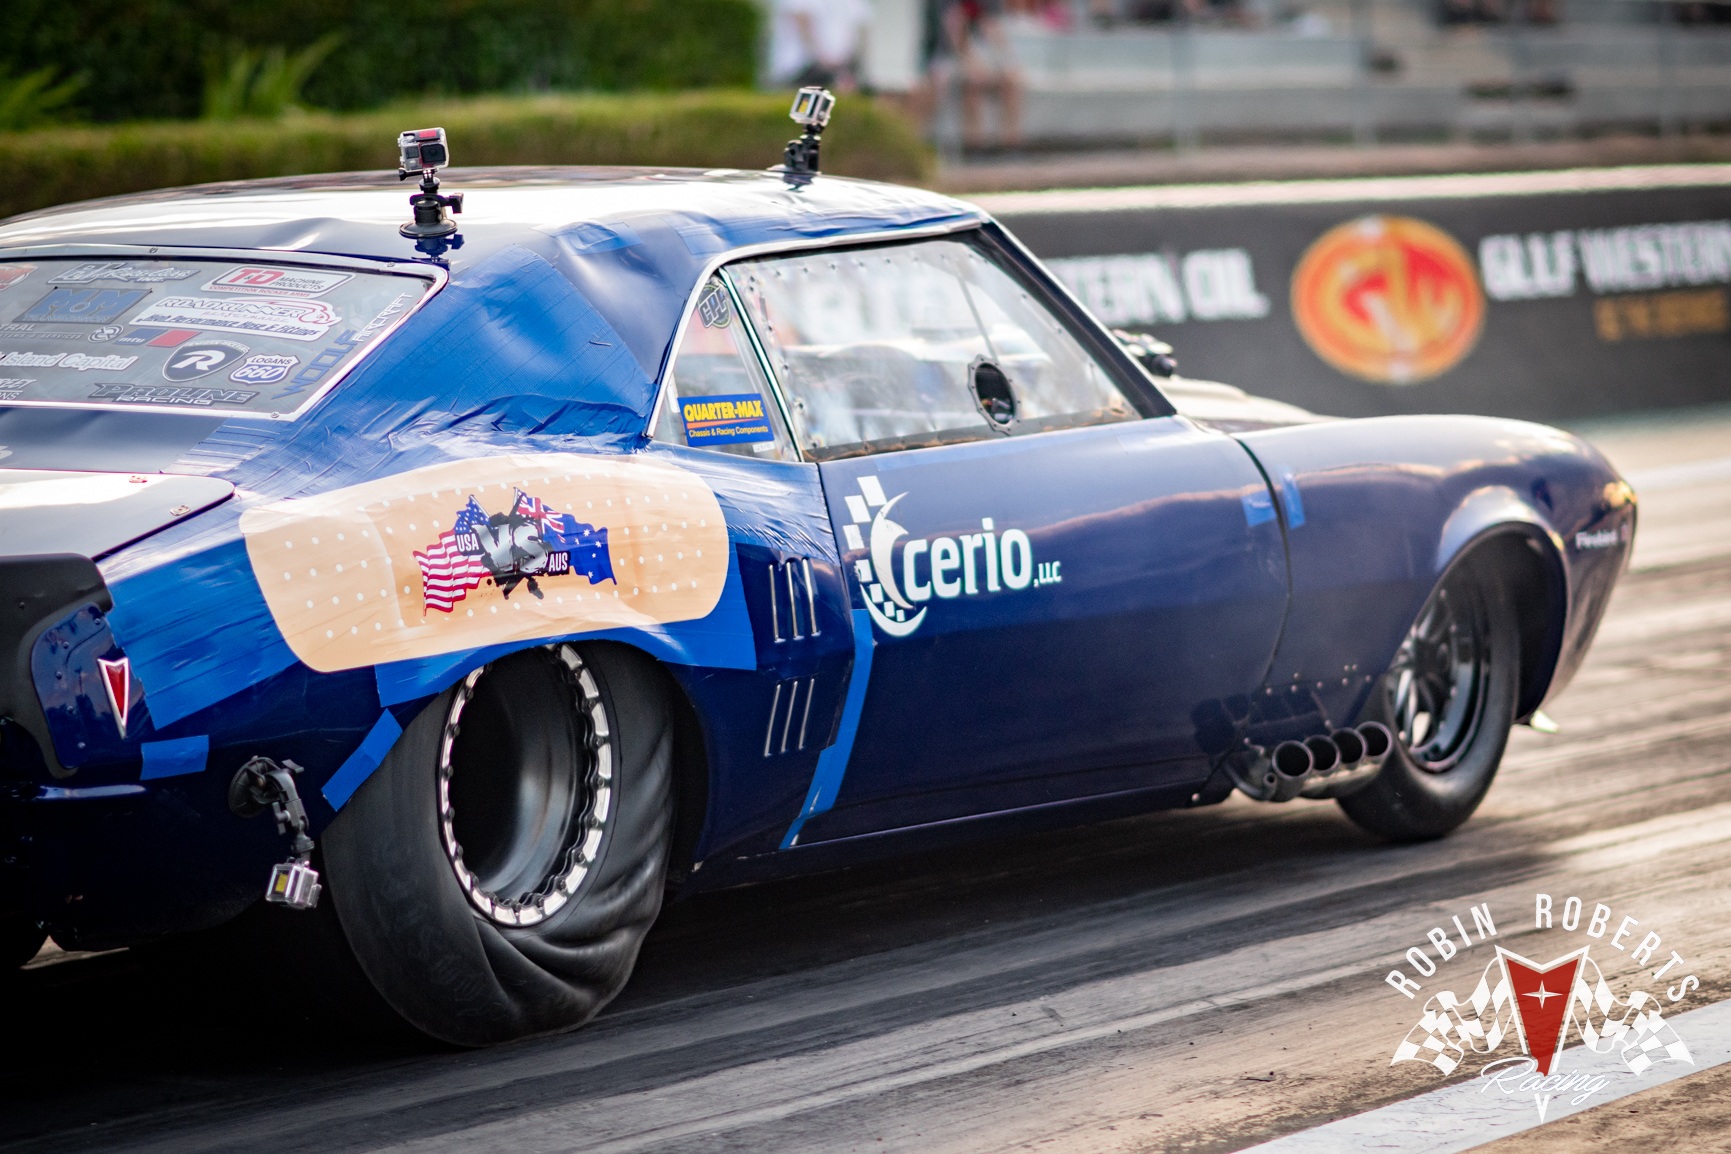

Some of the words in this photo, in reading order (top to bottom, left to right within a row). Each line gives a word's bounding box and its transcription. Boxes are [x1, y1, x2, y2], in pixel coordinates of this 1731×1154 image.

[209, 285, 258, 293] COMPETITION
[269, 281, 324, 290] PRODUCTS
[156, 299, 307, 319] ROADRUNNER
[270, 329, 357, 400] WOLF
[352, 293, 413, 342] AIRCRAFT
[1, 352, 66, 366] Island
[60, 354, 137, 370] Capital
[250, 356, 293, 366] LOGANS
[236, 366, 283, 379] 660
[92, 383, 257, 403] PROLINE
[116, 396, 213, 405] RACING
[684, 400, 764, 422] QUARTER-MAX
[688, 429, 711, 437] Chassis
[711, 428, 716, 436] &
[716, 427, 735, 436] Racing
[735, 425, 769, 435] Components
[456, 533, 479, 552] USA
[471, 521, 548, 574] VS
[548, 552, 568, 572] AUS
[903, 517, 1032, 601] cerio
